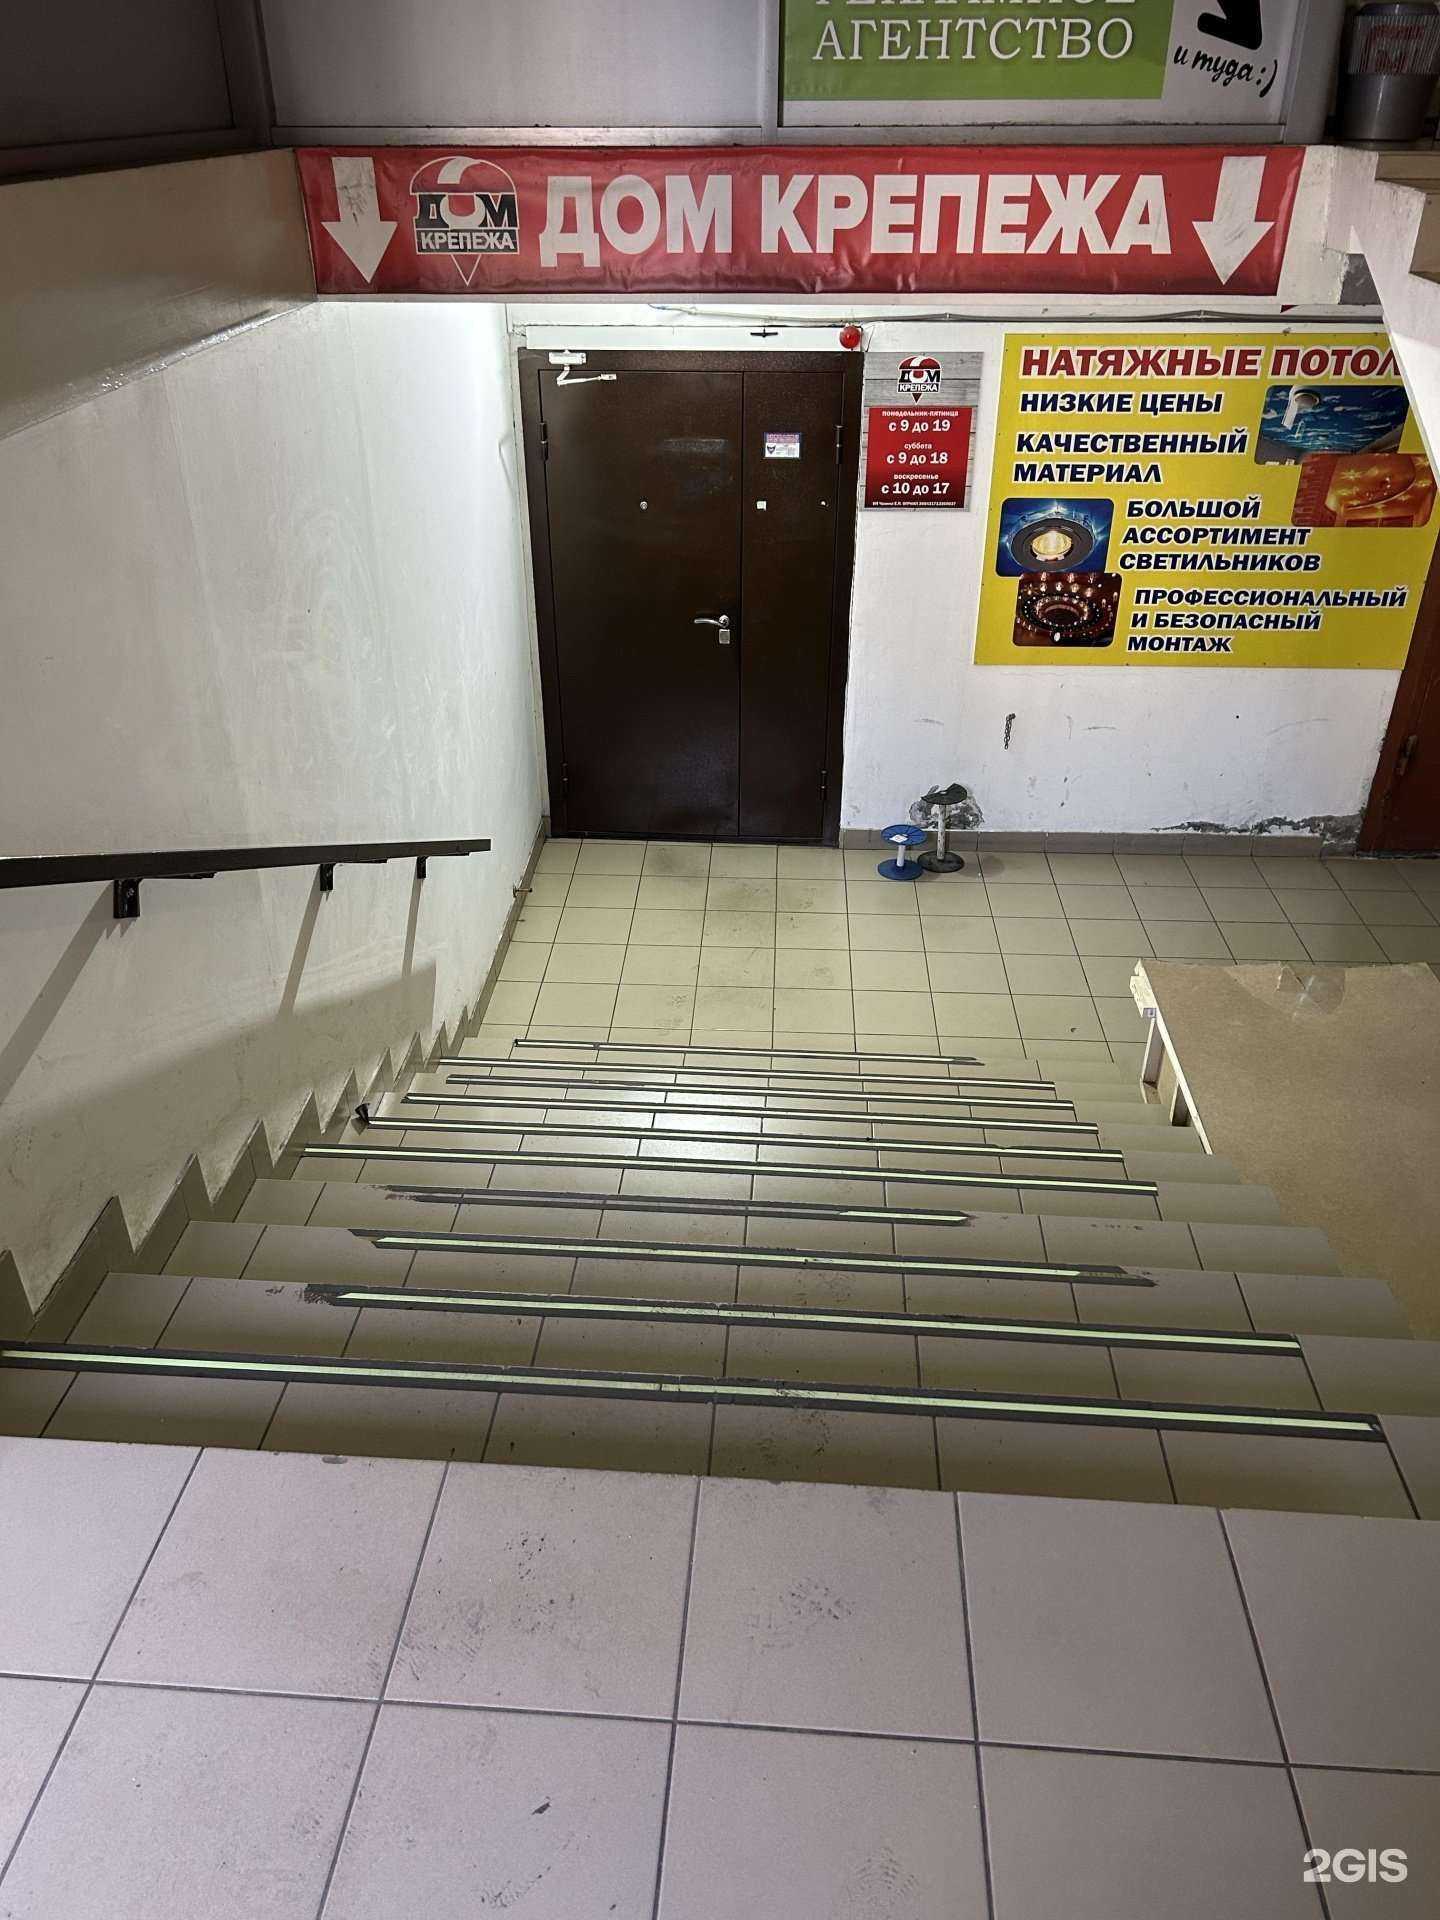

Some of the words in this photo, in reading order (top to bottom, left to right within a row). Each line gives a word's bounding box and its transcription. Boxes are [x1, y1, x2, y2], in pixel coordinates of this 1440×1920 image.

[812, 17, 1134, 61] АГЕНТСТВО
[1173, 45, 1188, 65] и
[417, 193, 518, 229] ДОМ
[539, 173, 733, 268] ДОМ
[760, 172, 1172, 256] КРЕПЕЖА
[420, 230, 515, 250] КРЕПЕЖА
[1020, 348, 1262, 378] НАТЯЖНЫЕ
[898, 368, 941, 383] ДОМ
[898, 383, 939, 392] КРЕПЕЖА
[1020, 392, 1132, 413] НИЗКИЕ
[1139, 393, 1223, 415] ЦЕНЫ
[888, 422, 897, 432] с
[900, 419, 910, 432] 9
[912, 422, 929, 433] до
[932, 419, 951, 432] 19
[904, 442, 933, 451] суббота
[1016, 428, 1248, 454] КАЧЕСТВЕННЫЙ
[886, 454, 895, 464] с
[898, 451, 907, 464] 9
[910, 454, 927, 465] до
[930, 451, 948, 464] 18
[1013, 463, 1162, 483] МАТЕРИАЛ
[881, 484, 890, 494] с
[892, 482, 911, 494] 10
[912, 485, 930, 495] до
[932, 482, 950, 494] 17
[1127, 496, 1261, 519] БОЛЬШОЙ
[1122, 527, 1311, 545] АССОРТИМЕНТ
[1119, 553, 1321, 572] СВЕТИЛЬНИКОВ
[1134, 586, 1408, 608] ПРОФЕССИОНАЛЬНЫЙ
[1131, 614, 1148, 629] И
[1154, 611, 1321, 630] БЕЗОПАСНЫЙ
[1127, 636, 1233, 652] МОНТАЖ
